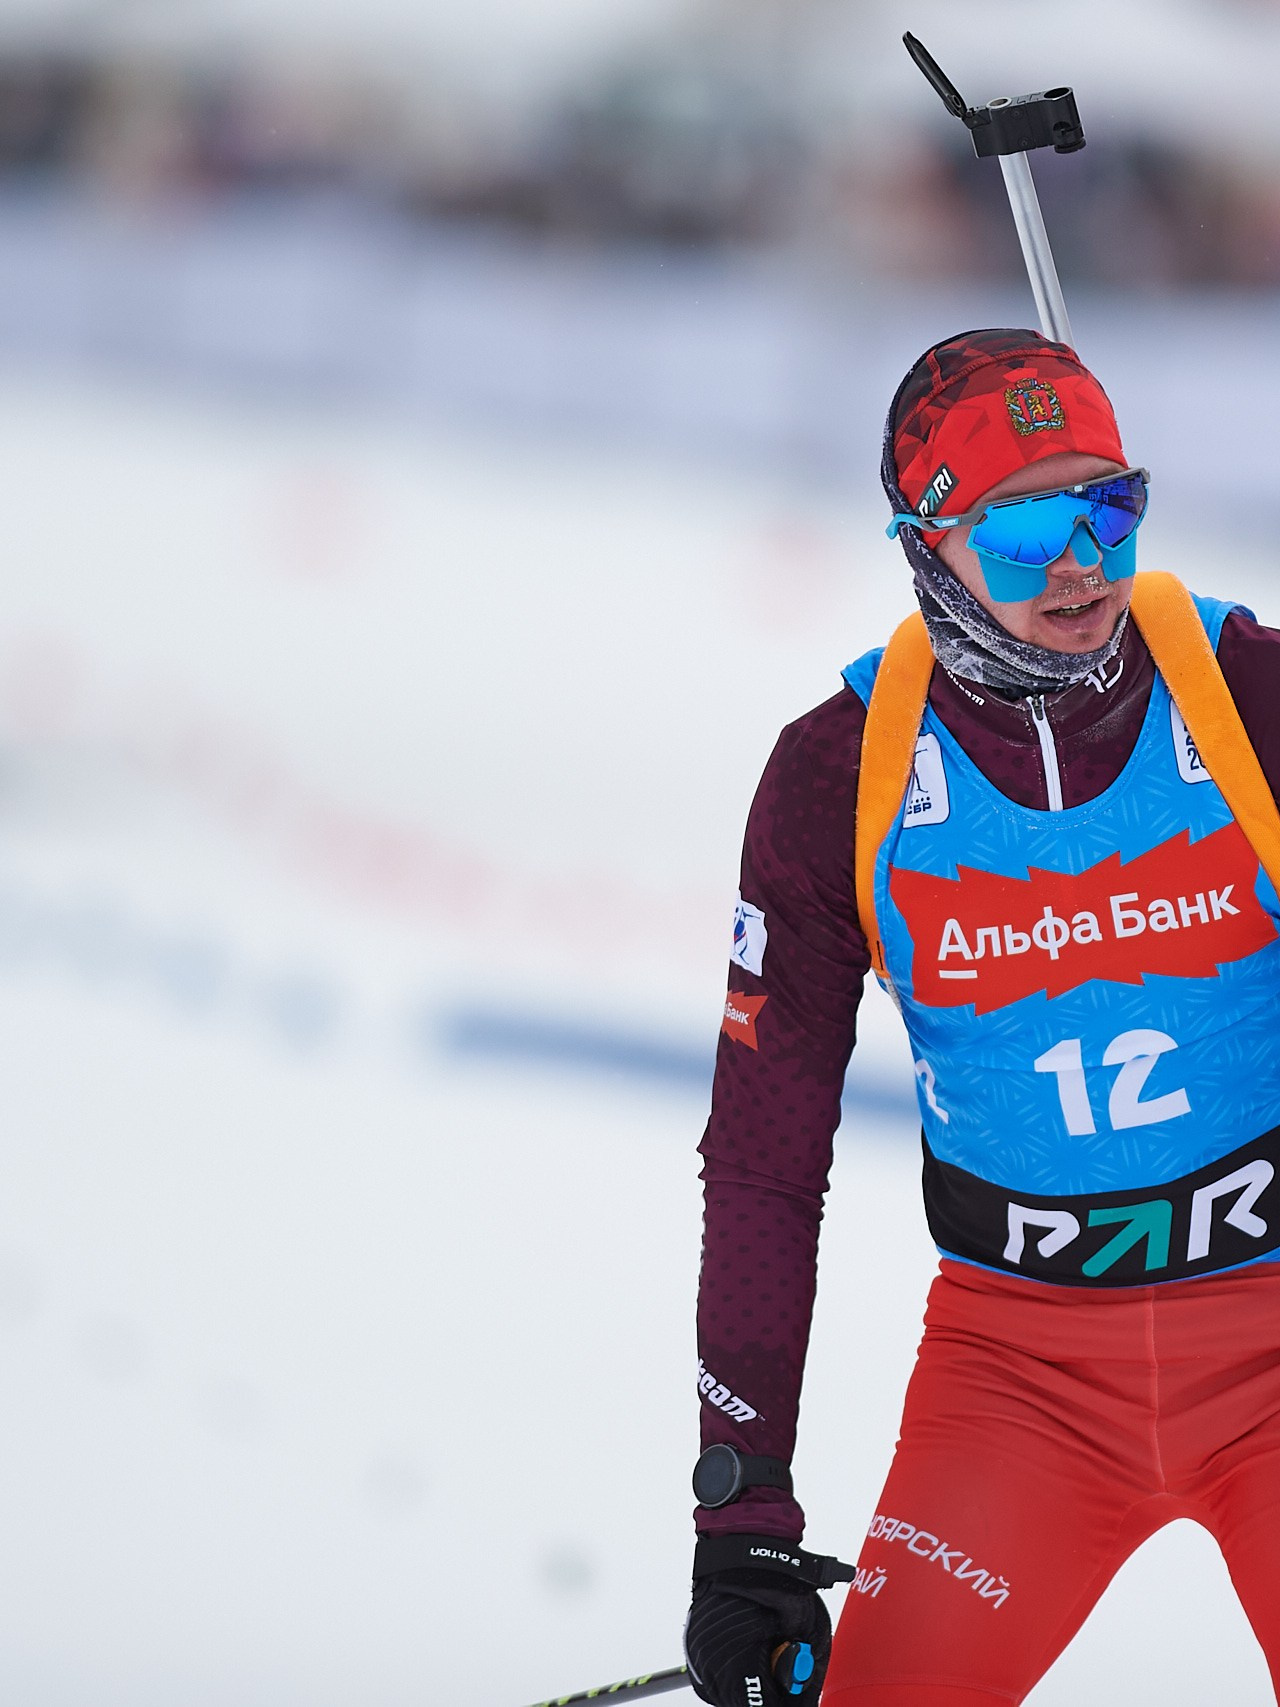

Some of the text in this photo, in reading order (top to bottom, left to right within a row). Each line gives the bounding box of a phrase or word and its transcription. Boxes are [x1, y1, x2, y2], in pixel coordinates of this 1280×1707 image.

[938, 884, 1241, 962] Альфа Банк
[1034, 1029, 1192, 1136] 12
